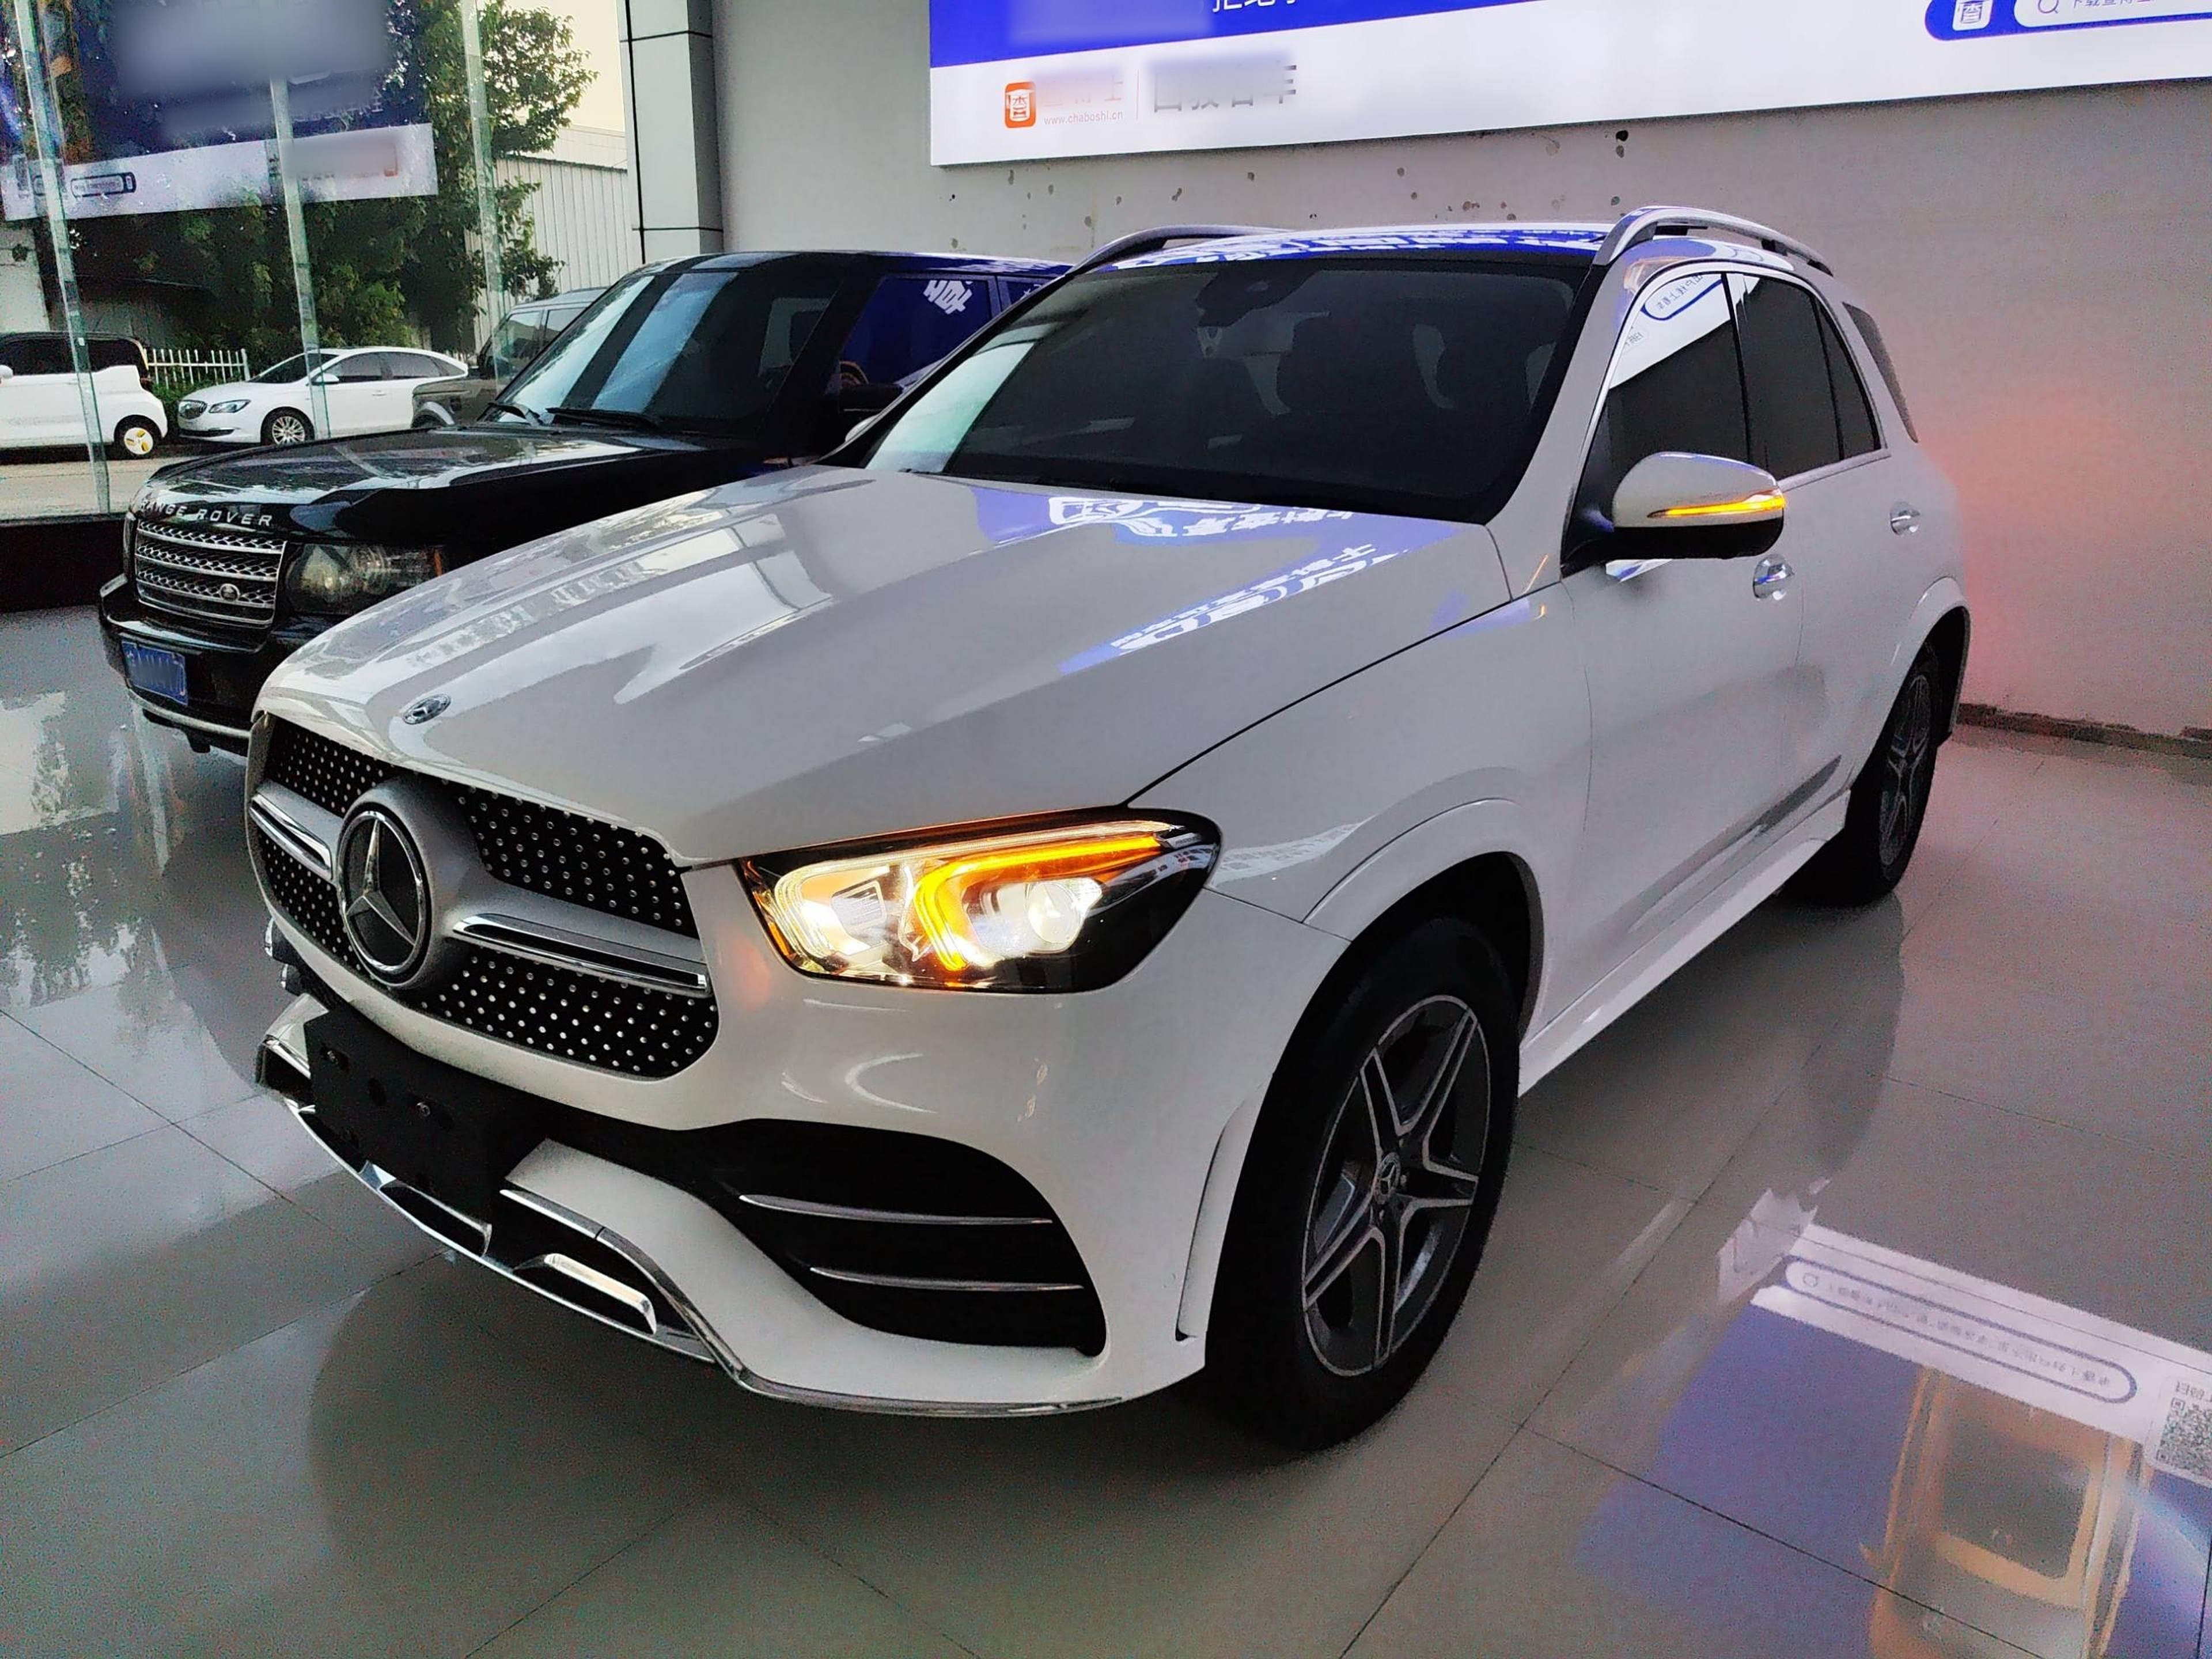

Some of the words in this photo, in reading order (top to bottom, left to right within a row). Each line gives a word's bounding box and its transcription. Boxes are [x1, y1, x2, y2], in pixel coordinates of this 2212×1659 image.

[1044, 110, 1123, 125] www.chaboshi.cn
[140, 499, 188, 516] RANGE
[196, 509, 272, 527] ROVER
